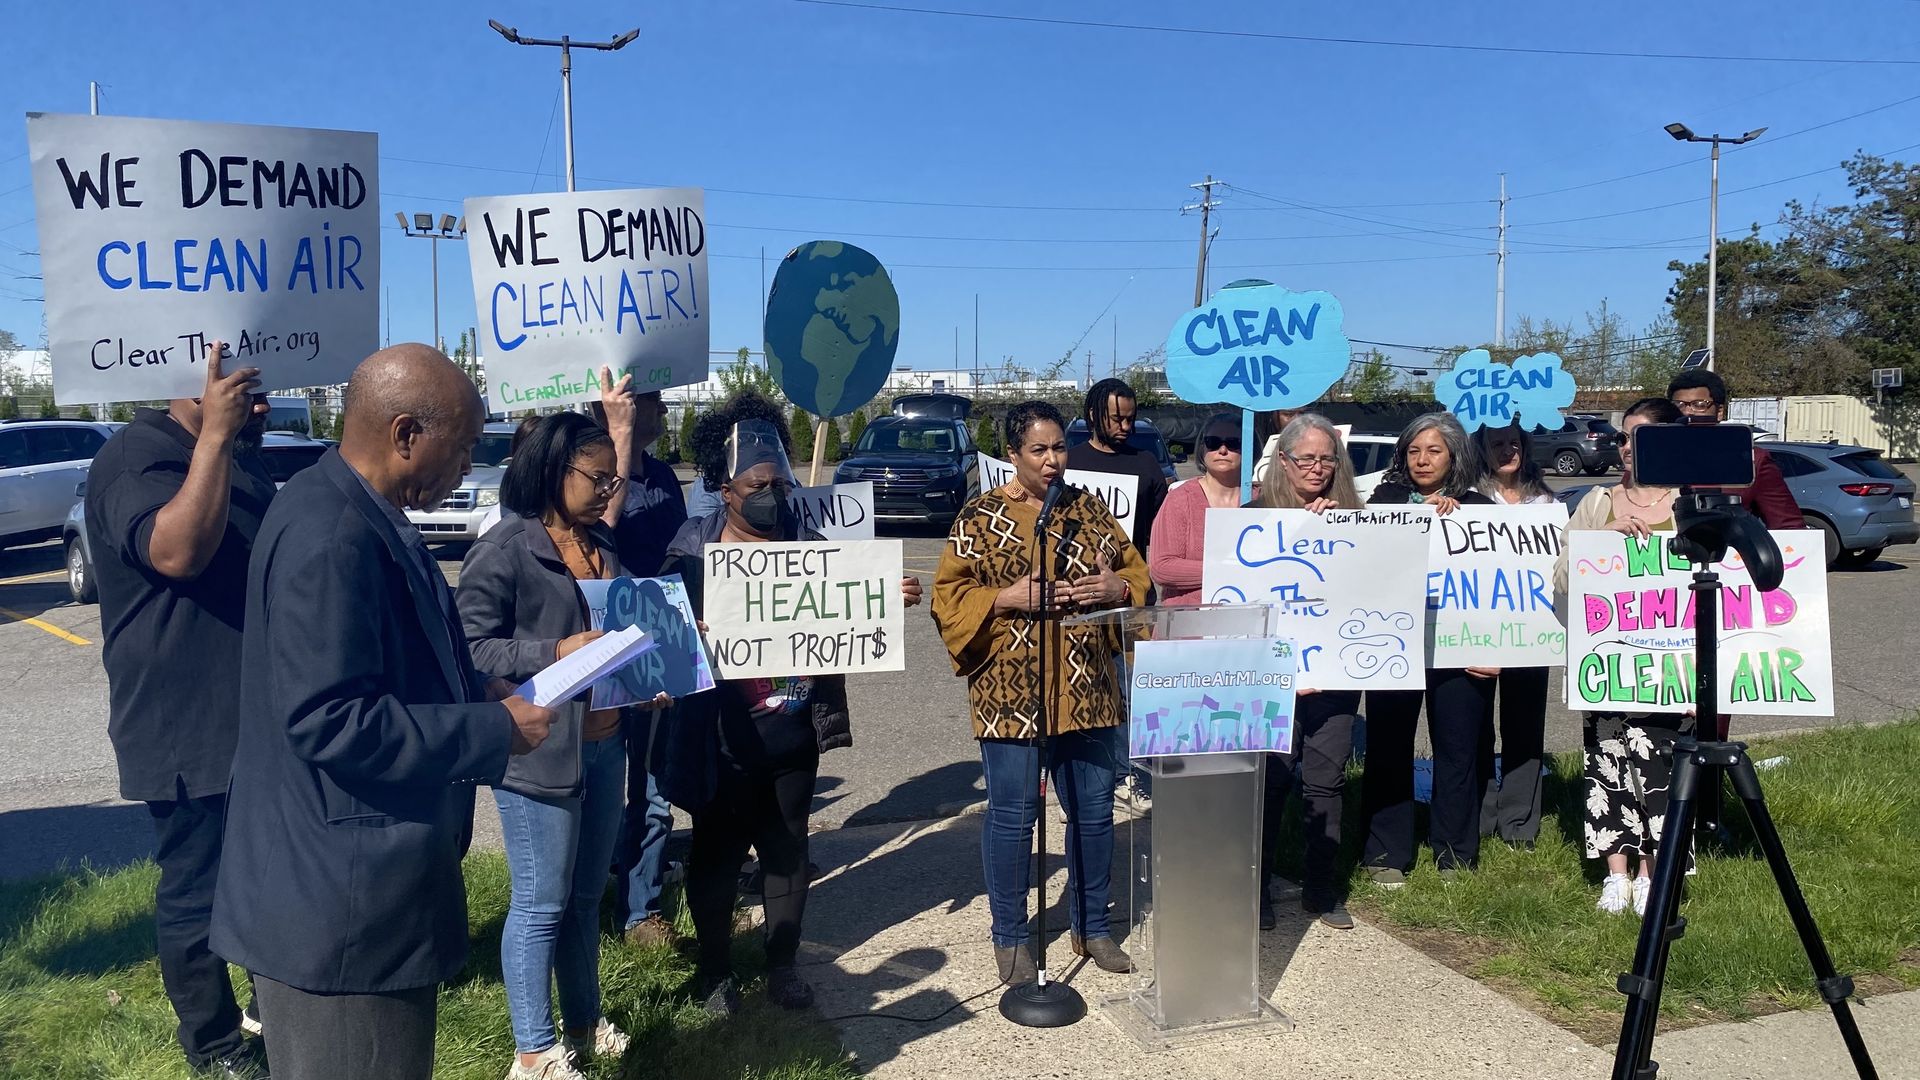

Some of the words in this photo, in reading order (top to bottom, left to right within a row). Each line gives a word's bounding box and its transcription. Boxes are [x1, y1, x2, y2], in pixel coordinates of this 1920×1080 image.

[56, 152, 143, 209] WE
[179, 149, 366, 210] DEMAND
[483, 207, 559, 268] WE
[578, 206, 704, 262] DEMAND
[97, 238, 268, 292] CLEAN
[492, 275, 604, 350] CLEAN
[617, 263, 699, 335] AIR!
[1185, 303, 1320, 355] CLEAN
[1218, 356, 1290, 397] AIR
[1456, 366, 1553, 390] CLEAN
[1453, 391, 1511, 421] AIR
[709, 548, 841, 578] PROTECT
[1236, 521, 1355, 582] Clear
[746, 578, 886, 622] HEALTH
[1427, 568, 1479, 610] EAN
[1491, 568, 1556, 612] AIR
[714, 637, 773, 668] NOT
[1136, 671, 1292, 689] ClearTheAirMI.org
[1732, 648, 1816, 704] AIR
